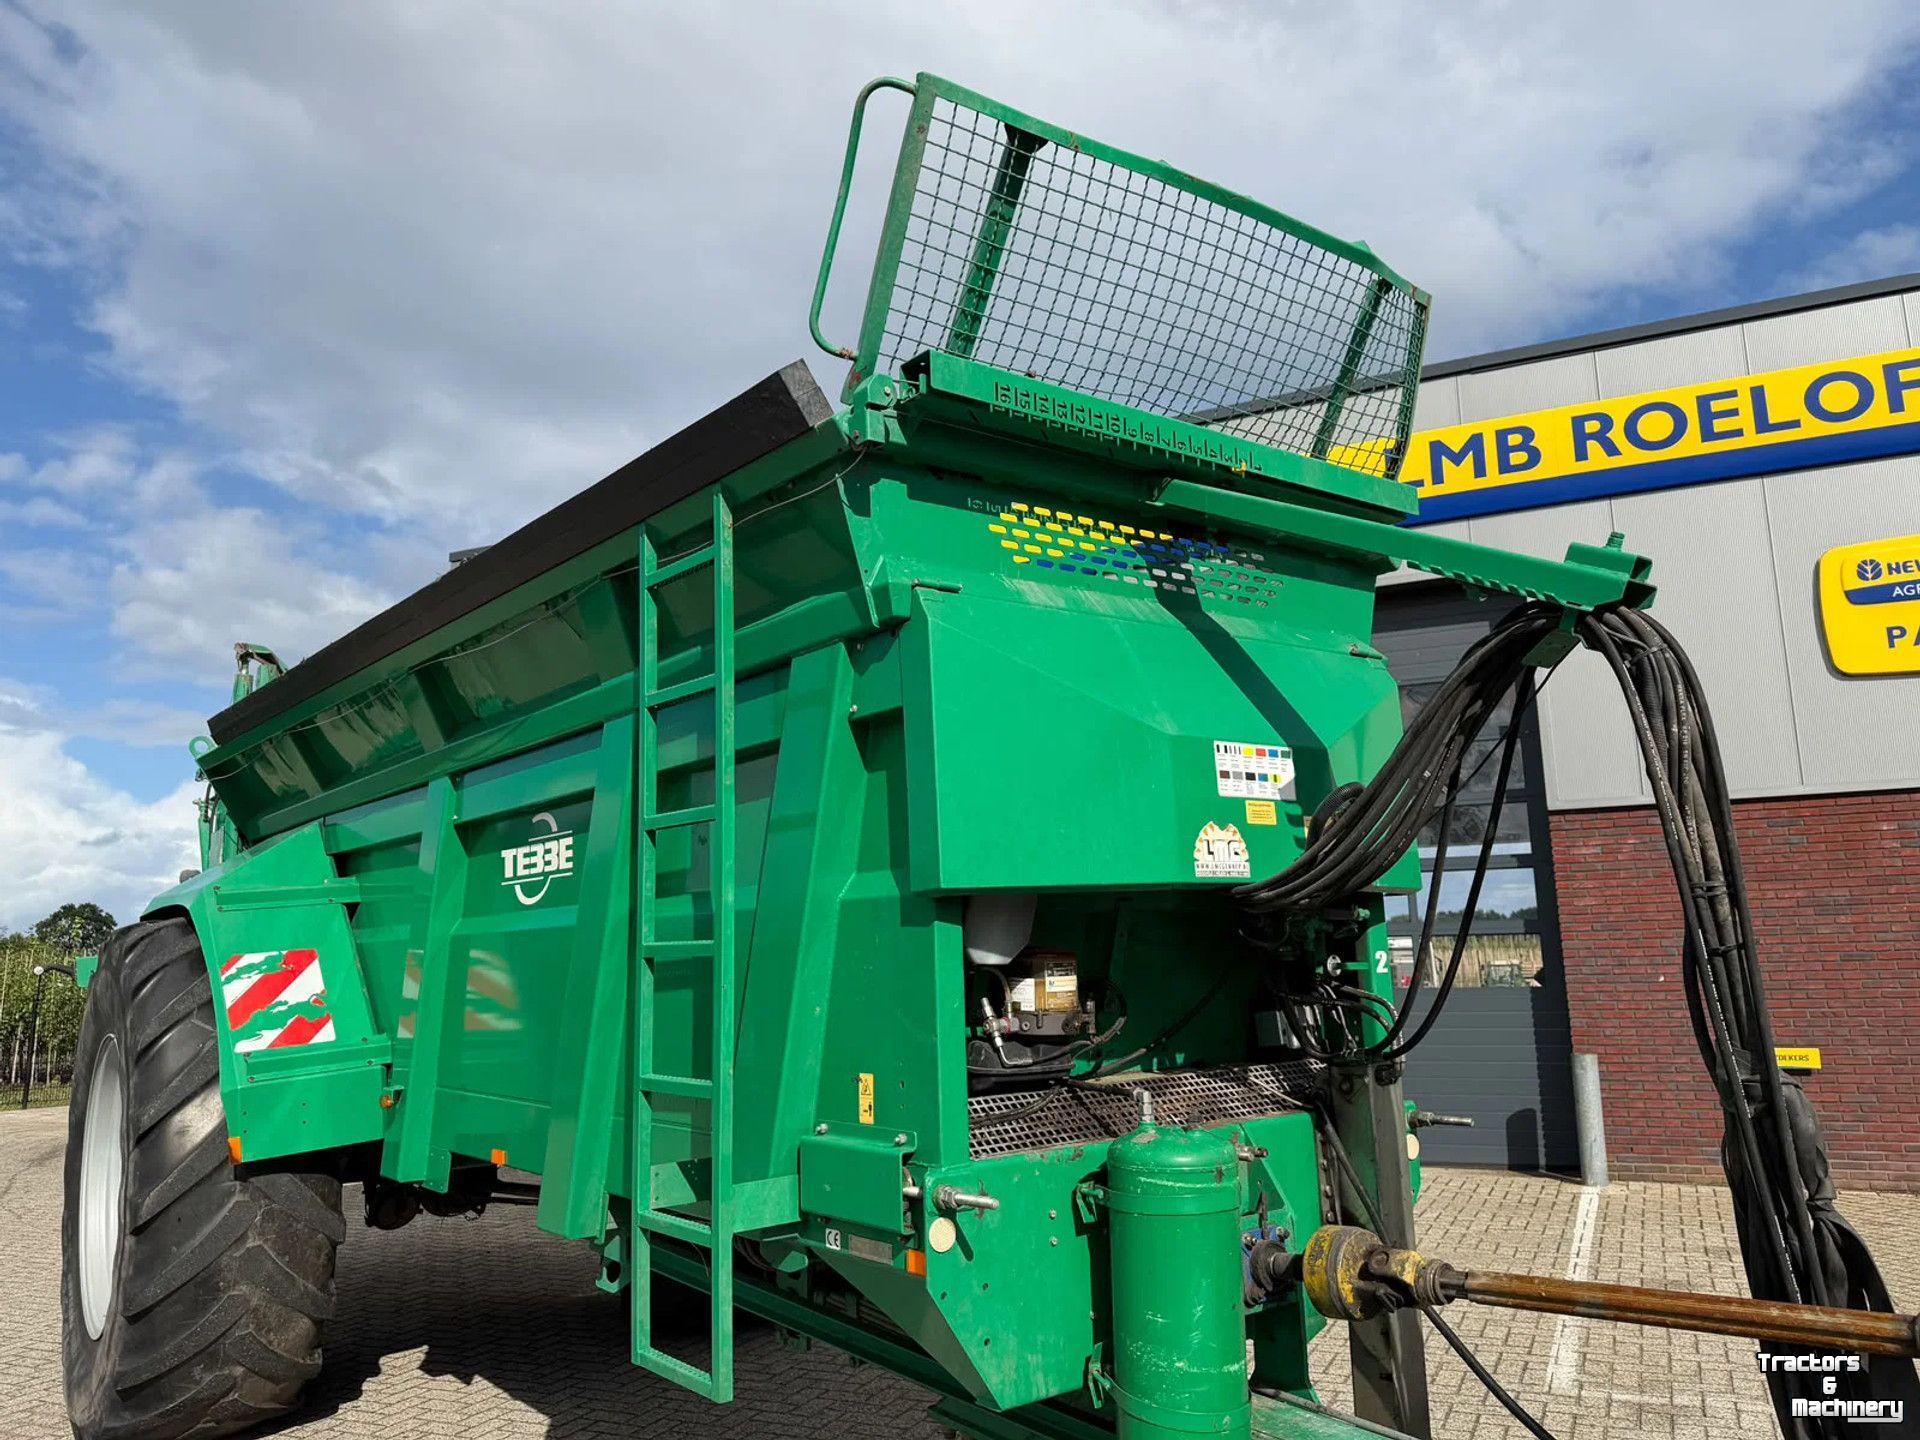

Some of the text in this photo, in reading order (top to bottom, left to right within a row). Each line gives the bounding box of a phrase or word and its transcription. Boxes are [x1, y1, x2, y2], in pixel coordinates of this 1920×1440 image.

[1019, 390, 1031, 409] 15
[1038, 394, 1049, 414] 14
[1057, 401, 1068, 420] 13
[1075, 406, 1085, 425] 12
[1093, 411, 1104, 430] 11
[1110, 414, 1120, 434] 10
[1571, 358, 1920, 462] ROELOF
[501, 836, 574, 879] TEBBE
[1374, 951, 1389, 974] 2
